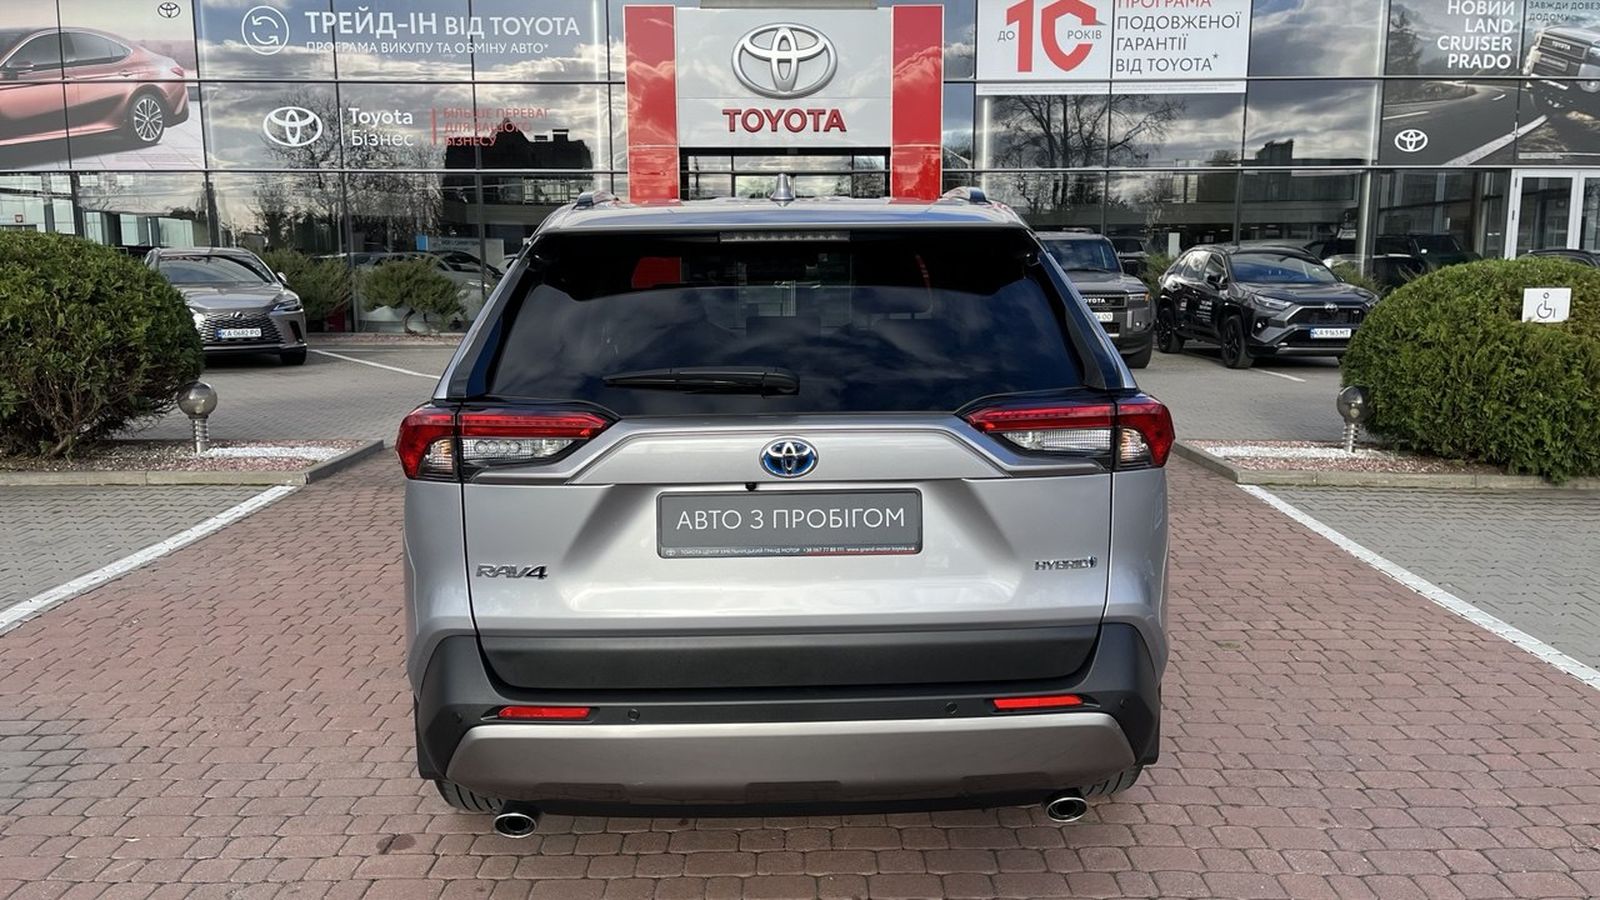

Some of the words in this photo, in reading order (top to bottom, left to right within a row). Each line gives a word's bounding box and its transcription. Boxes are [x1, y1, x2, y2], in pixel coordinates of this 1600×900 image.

[1529, 1, 1569, 10] ЗАВЖДИ
[305, 6, 437, 39] ТРЕЙД-ІН
[445, 17, 485, 39] ВІД
[489, 16, 581, 36] TOYOTA
[1117, 11, 1242, 32] ПОДОВЖЕНОЇ
[1465, 18, 1514, 33] LAND
[1529, 13, 1569, 22] ДОДОМУ
[997, 31, 1016, 42] ДО
[1067, 30, 1102, 39] РОКІВ
[1117, 33, 1189, 51] ГАРАНТІЇ
[1437, 35, 1512, 51] CRUISER
[306, 42, 378, 53] ПРОГРАМА
[381, 43, 434, 54] ВИКУПУ
[436, 43, 453, 54] ТА
[455, 42, 507, 54] ОБМІНУ
[1116, 58, 1142, 74] ВІД
[1447, 53, 1511, 69] PRADO
[348, 108, 413, 127] Toyota
[496, 107, 551, 119] ПЕРЕВАГ
[722, 108, 847, 132] TOYOTA
[351, 129, 414, 147] Бізнес
[445, 136, 497, 146] БІЗНЕСУ
[676, 509, 742, 530] АВТО
[750, 510, 764, 530] З
[773, 508, 905, 529] ПРОБІГОМ
[476, 564, 548, 579] RAV4
[1034, 558, 1089, 571] HYBRID
